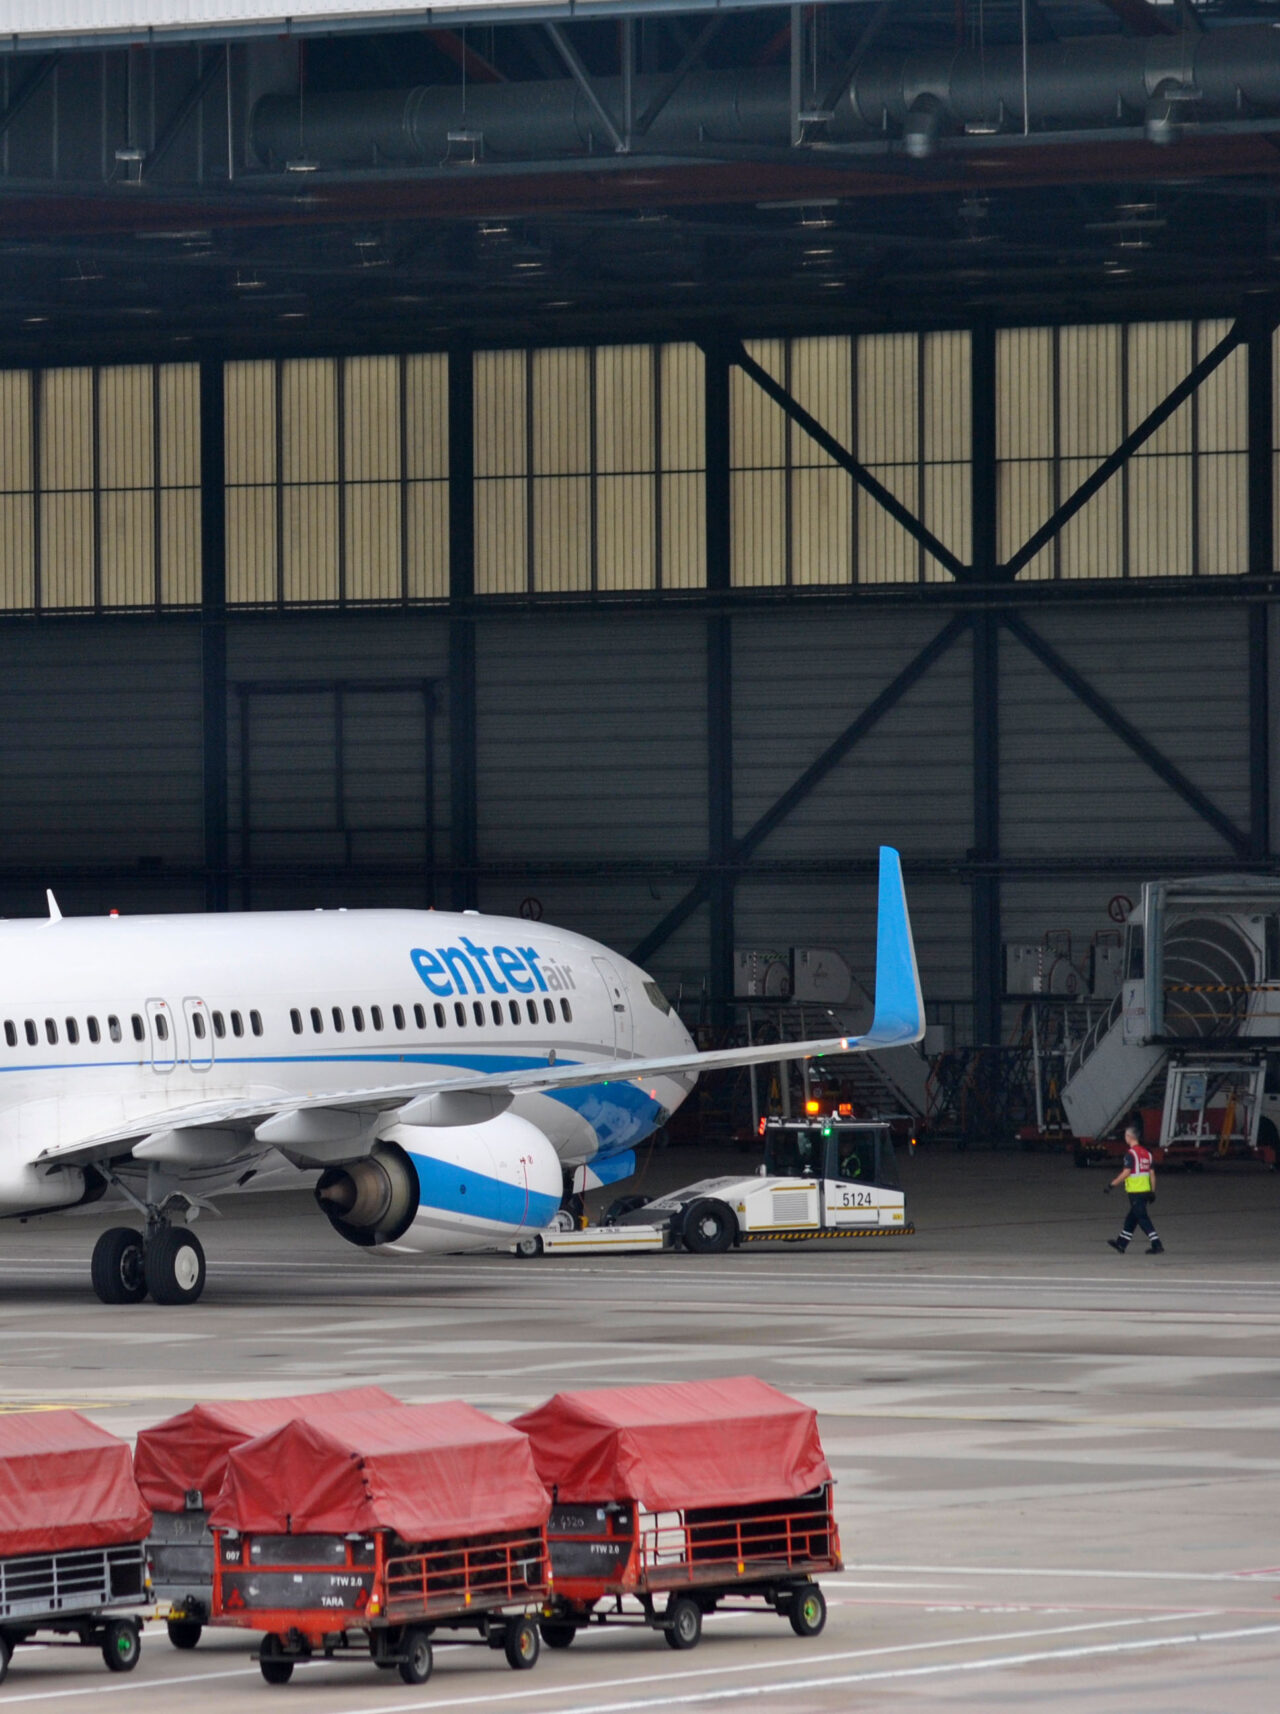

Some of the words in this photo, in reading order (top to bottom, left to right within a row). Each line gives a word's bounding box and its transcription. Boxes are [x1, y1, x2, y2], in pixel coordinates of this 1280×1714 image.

[410, 936, 549, 997] enter
[542, 957, 577, 992] air
[842, 1192, 872, 1207] 5124
[590, 1544, 607, 1553] FTW
[608, 1545, 620, 1554] 2.0
[225, 1550, 240, 1560] 007
[330, 1576, 349, 1586] FTW
[350, 1576, 363, 1587] 2.0
[321, 1597, 344, 1607] TARA
